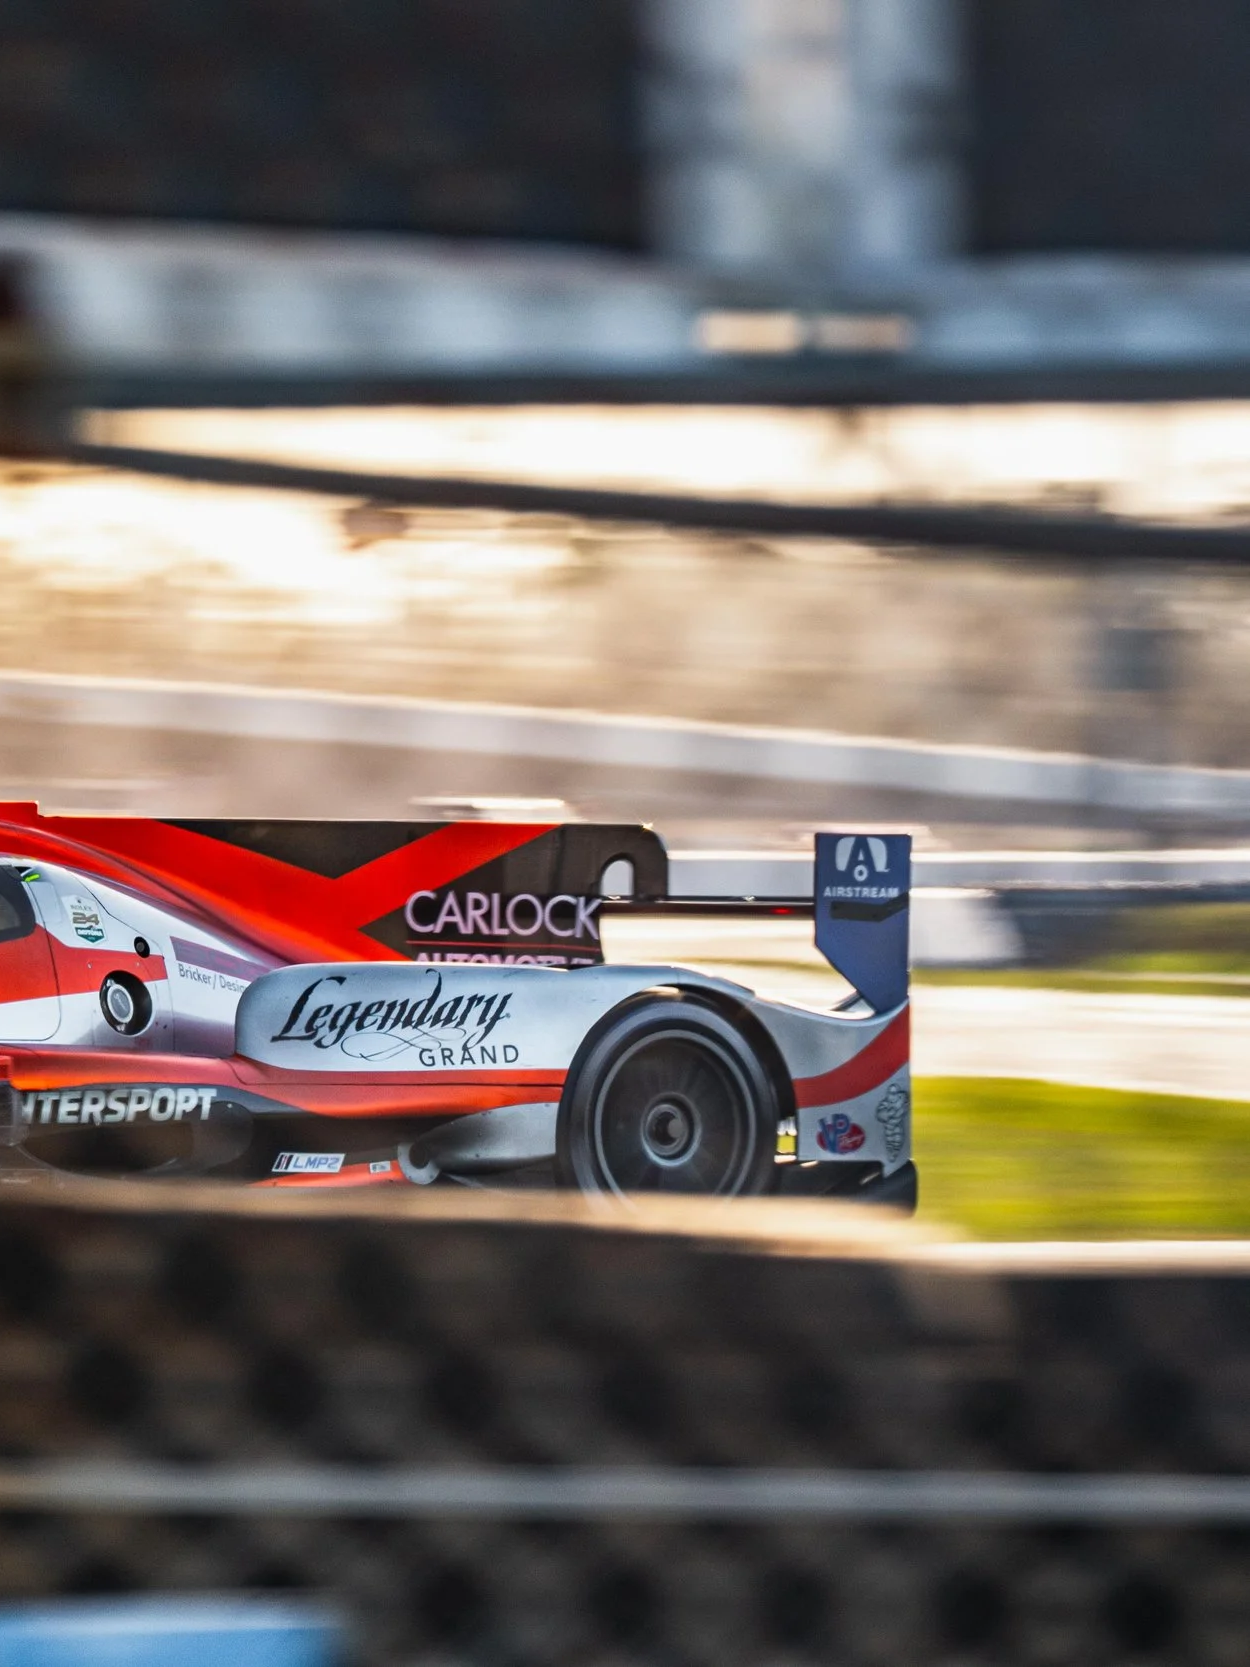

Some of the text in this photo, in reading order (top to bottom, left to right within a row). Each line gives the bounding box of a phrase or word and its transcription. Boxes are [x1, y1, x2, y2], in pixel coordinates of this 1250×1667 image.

[824, 886, 899, 898] AIRSTREAM
[72, 911, 99, 926] 24
[405, 890, 602, 940] CARLOCK
[178, 962, 211, 987] Bricker
[270, 968, 513, 1050] Legendary
[418, 1045, 519, 1067] GRAND
[818, 1113, 850, 1153] VP
[293, 1156, 340, 1169] LMP2
